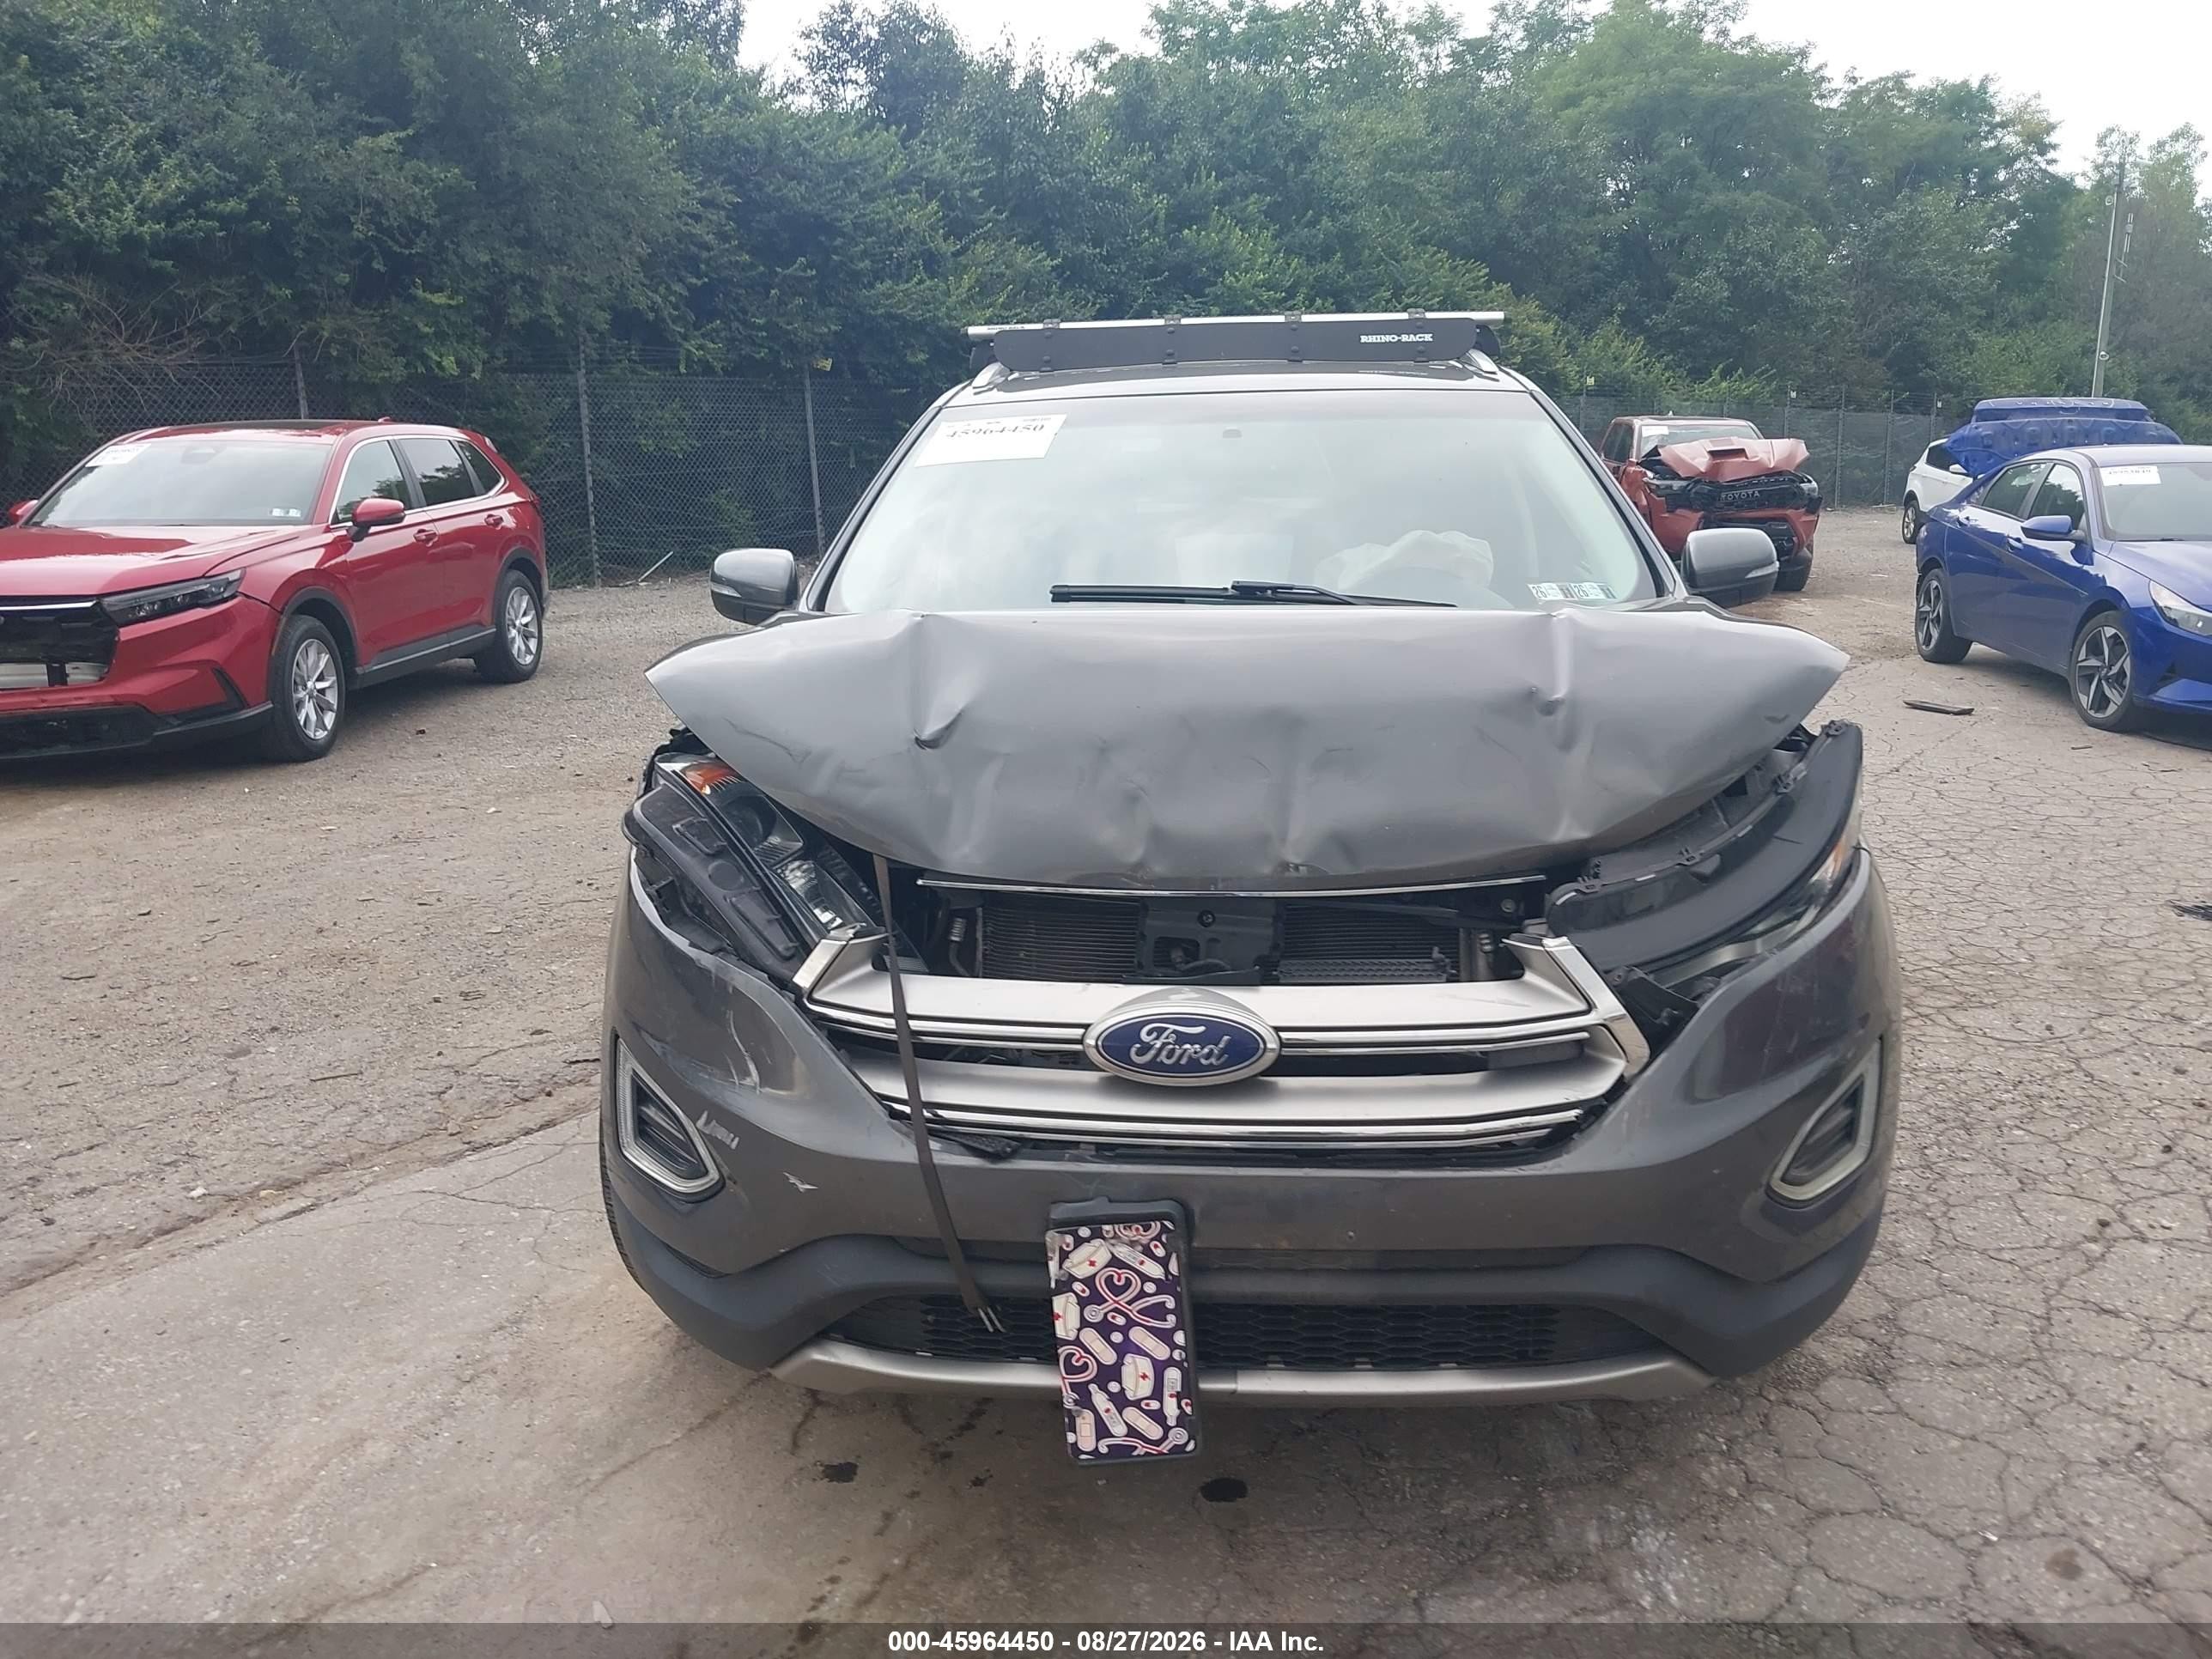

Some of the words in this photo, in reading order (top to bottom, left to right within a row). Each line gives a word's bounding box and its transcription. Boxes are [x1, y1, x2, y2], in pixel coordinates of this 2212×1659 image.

[1359, 333, 1433, 343] RHINO-RACK
[1721, 490, 1760, 501] TOYOTA
[1129, 1023, 1231, 1066] Ford
